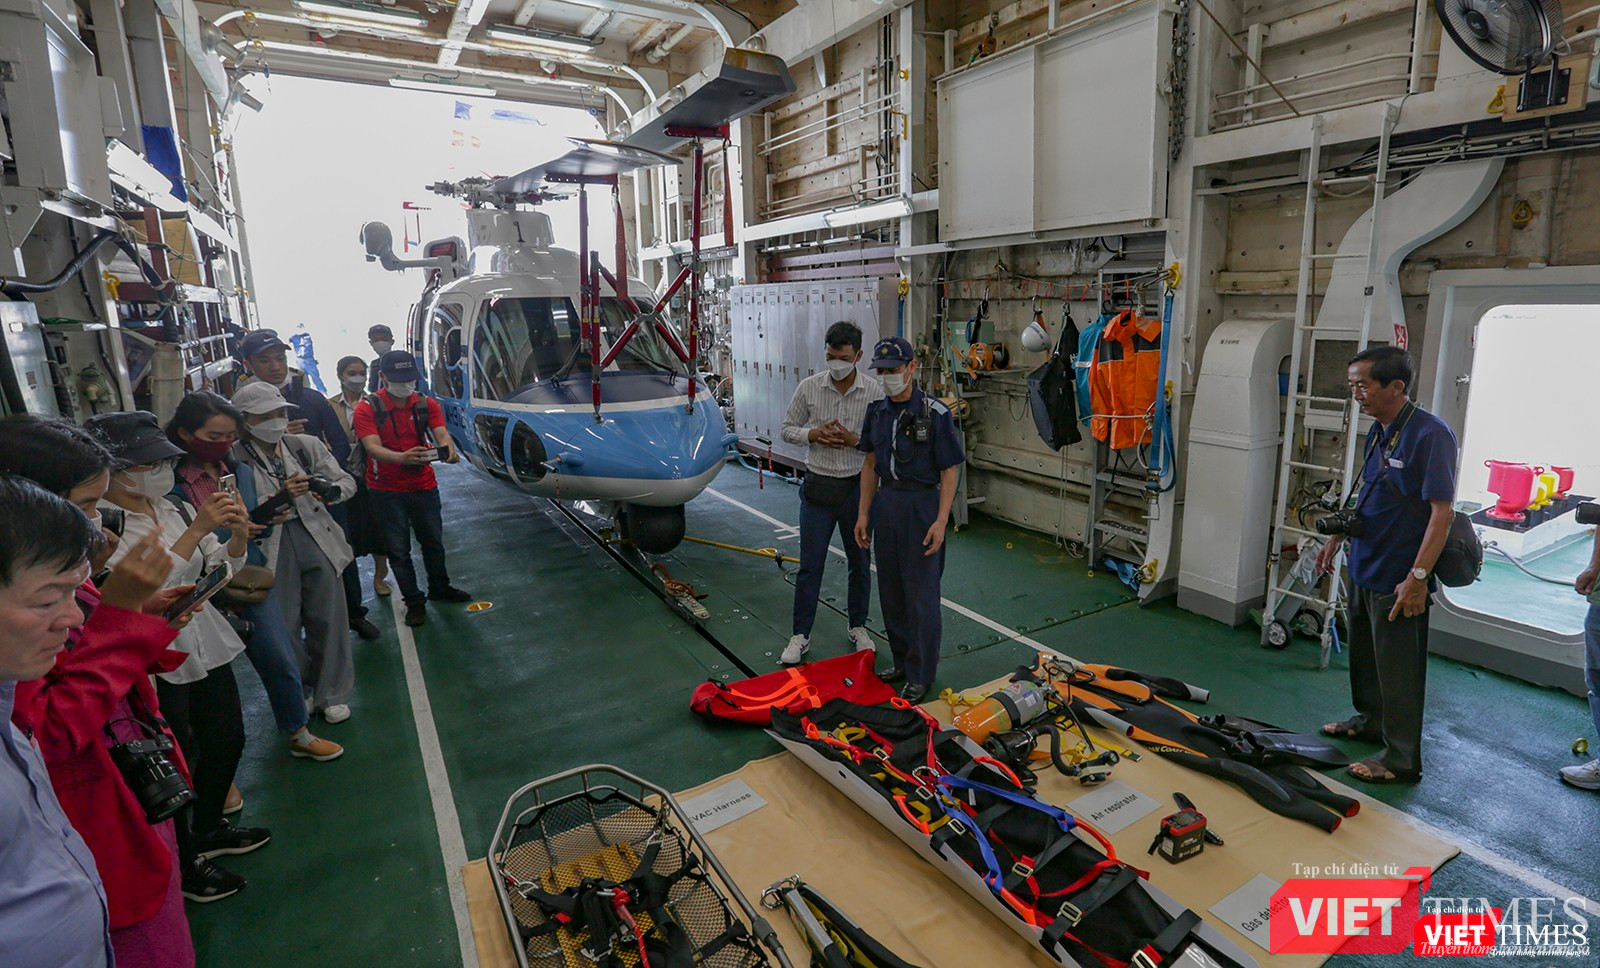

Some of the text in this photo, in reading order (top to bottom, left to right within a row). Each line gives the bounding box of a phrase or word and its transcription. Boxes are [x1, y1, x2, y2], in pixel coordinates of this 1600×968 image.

[713, 792, 752, 813] Harness
[1091, 793, 1139, 821] Air respirator
[1241, 918, 1263, 932] Gas
